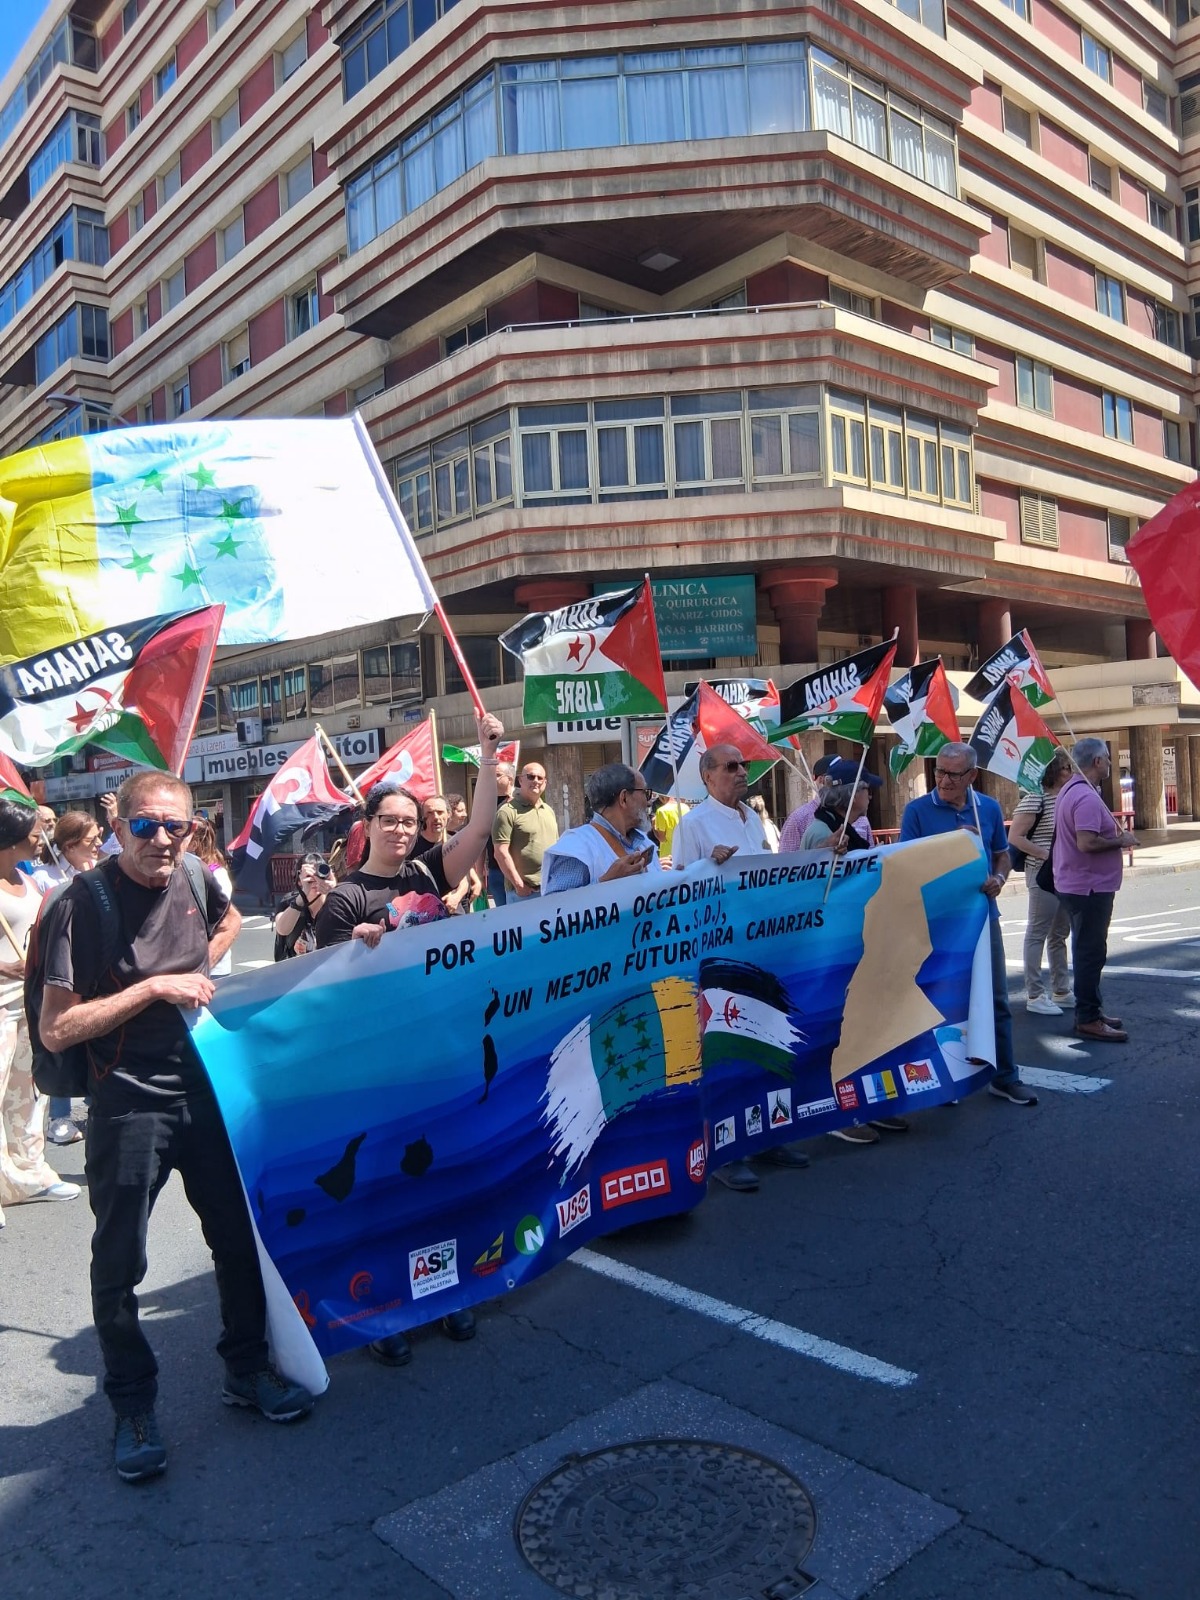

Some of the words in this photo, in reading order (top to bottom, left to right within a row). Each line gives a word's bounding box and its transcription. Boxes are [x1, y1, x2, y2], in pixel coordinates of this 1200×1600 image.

[652, 583, 708, 597] LINICA
[666, 596, 738, 610] QUIRURGICA
[672, 610, 705, 621] NARIZ
[711, 608, 744, 619] OIDOS
[694, 622, 744, 634] BARRIOS
[208, 748, 289, 775] muebles
[425, 939, 476, 976] POR
[493, 926, 522, 957] UN
[539, 902, 620, 945] SÁHARA
[633, 874, 727, 918] OCCIDENTAL
[738, 854, 879, 892] INDEPENDIENTE
[503, 987, 533, 1018] UN
[545, 961, 612, 1004] MEJOR
[623, 937, 699, 977] FUTURO
[701, 925, 734, 954] PARA
[746, 908, 825, 941] CANARIAS
[605, 1167, 666, 1201] CCOO
[559, 1189, 589, 1228] USO
[523, 1225, 545, 1251] N
[413, 1247, 455, 1281] ASP
